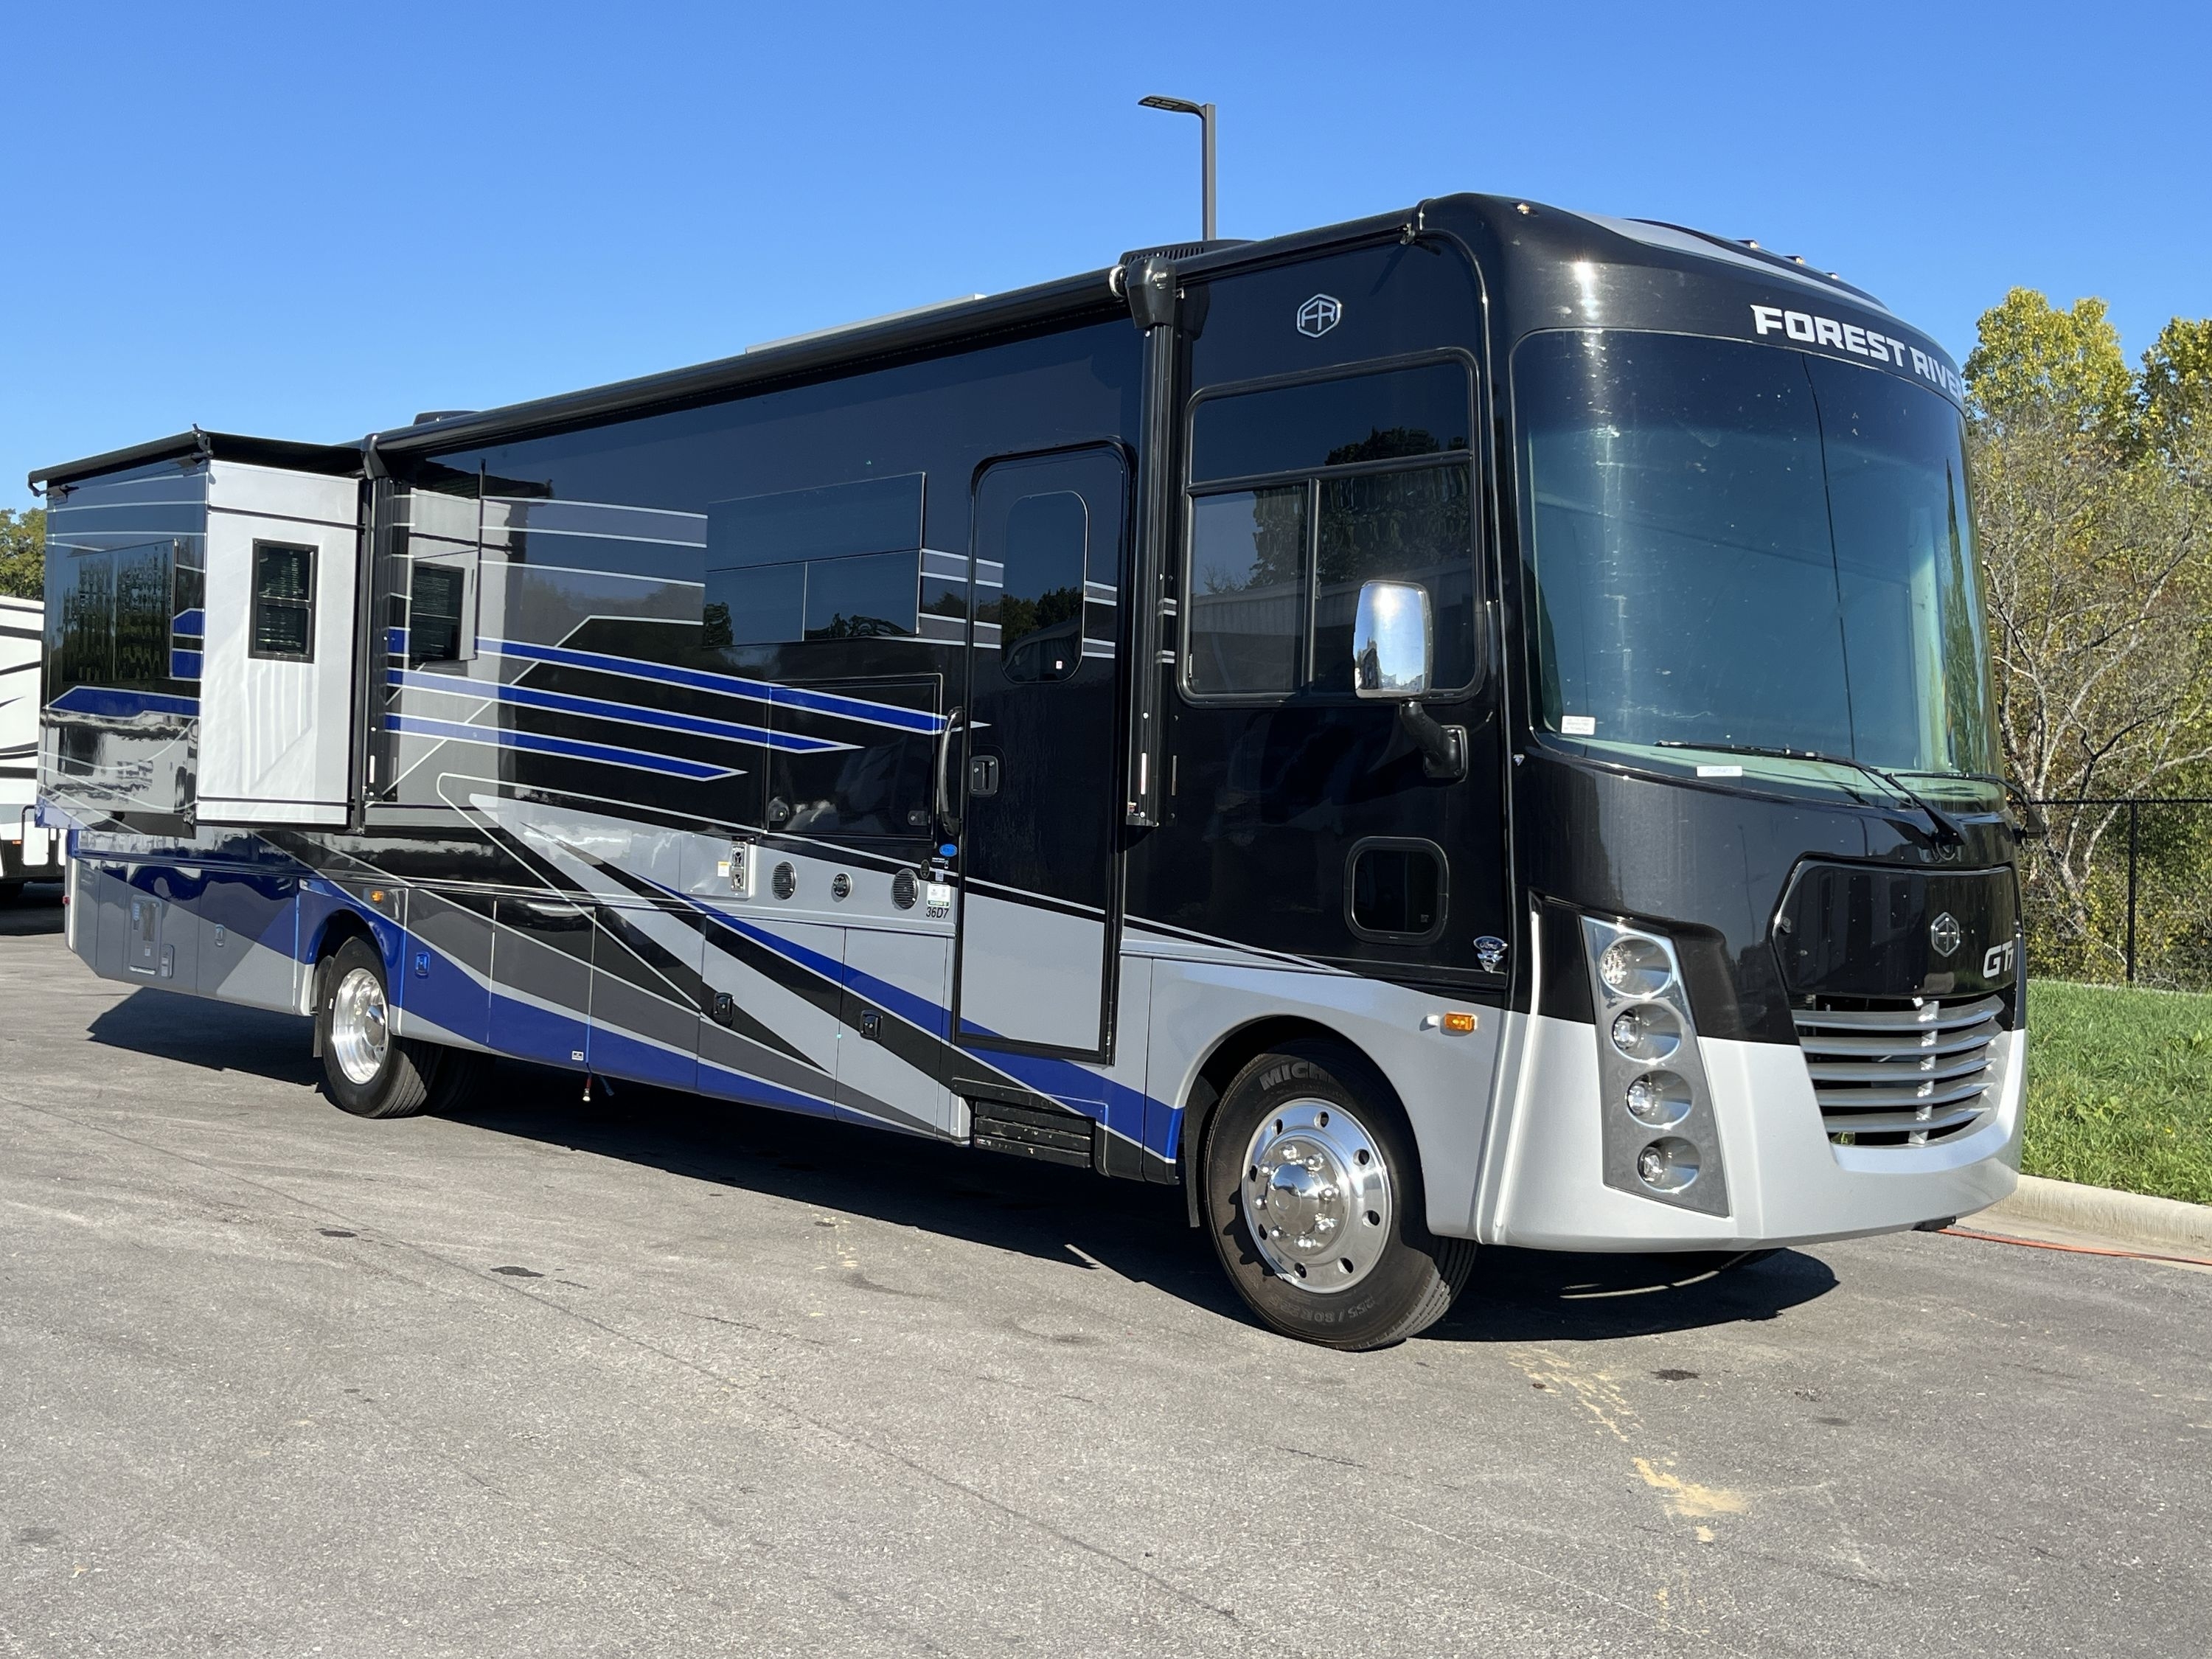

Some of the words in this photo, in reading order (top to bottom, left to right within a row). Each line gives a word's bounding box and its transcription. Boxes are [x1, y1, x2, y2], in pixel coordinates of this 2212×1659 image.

[1750, 304, 1905, 367] FOREST
[926, 907, 949, 919] 36D7
[1479, 941, 1499, 950] Ford
